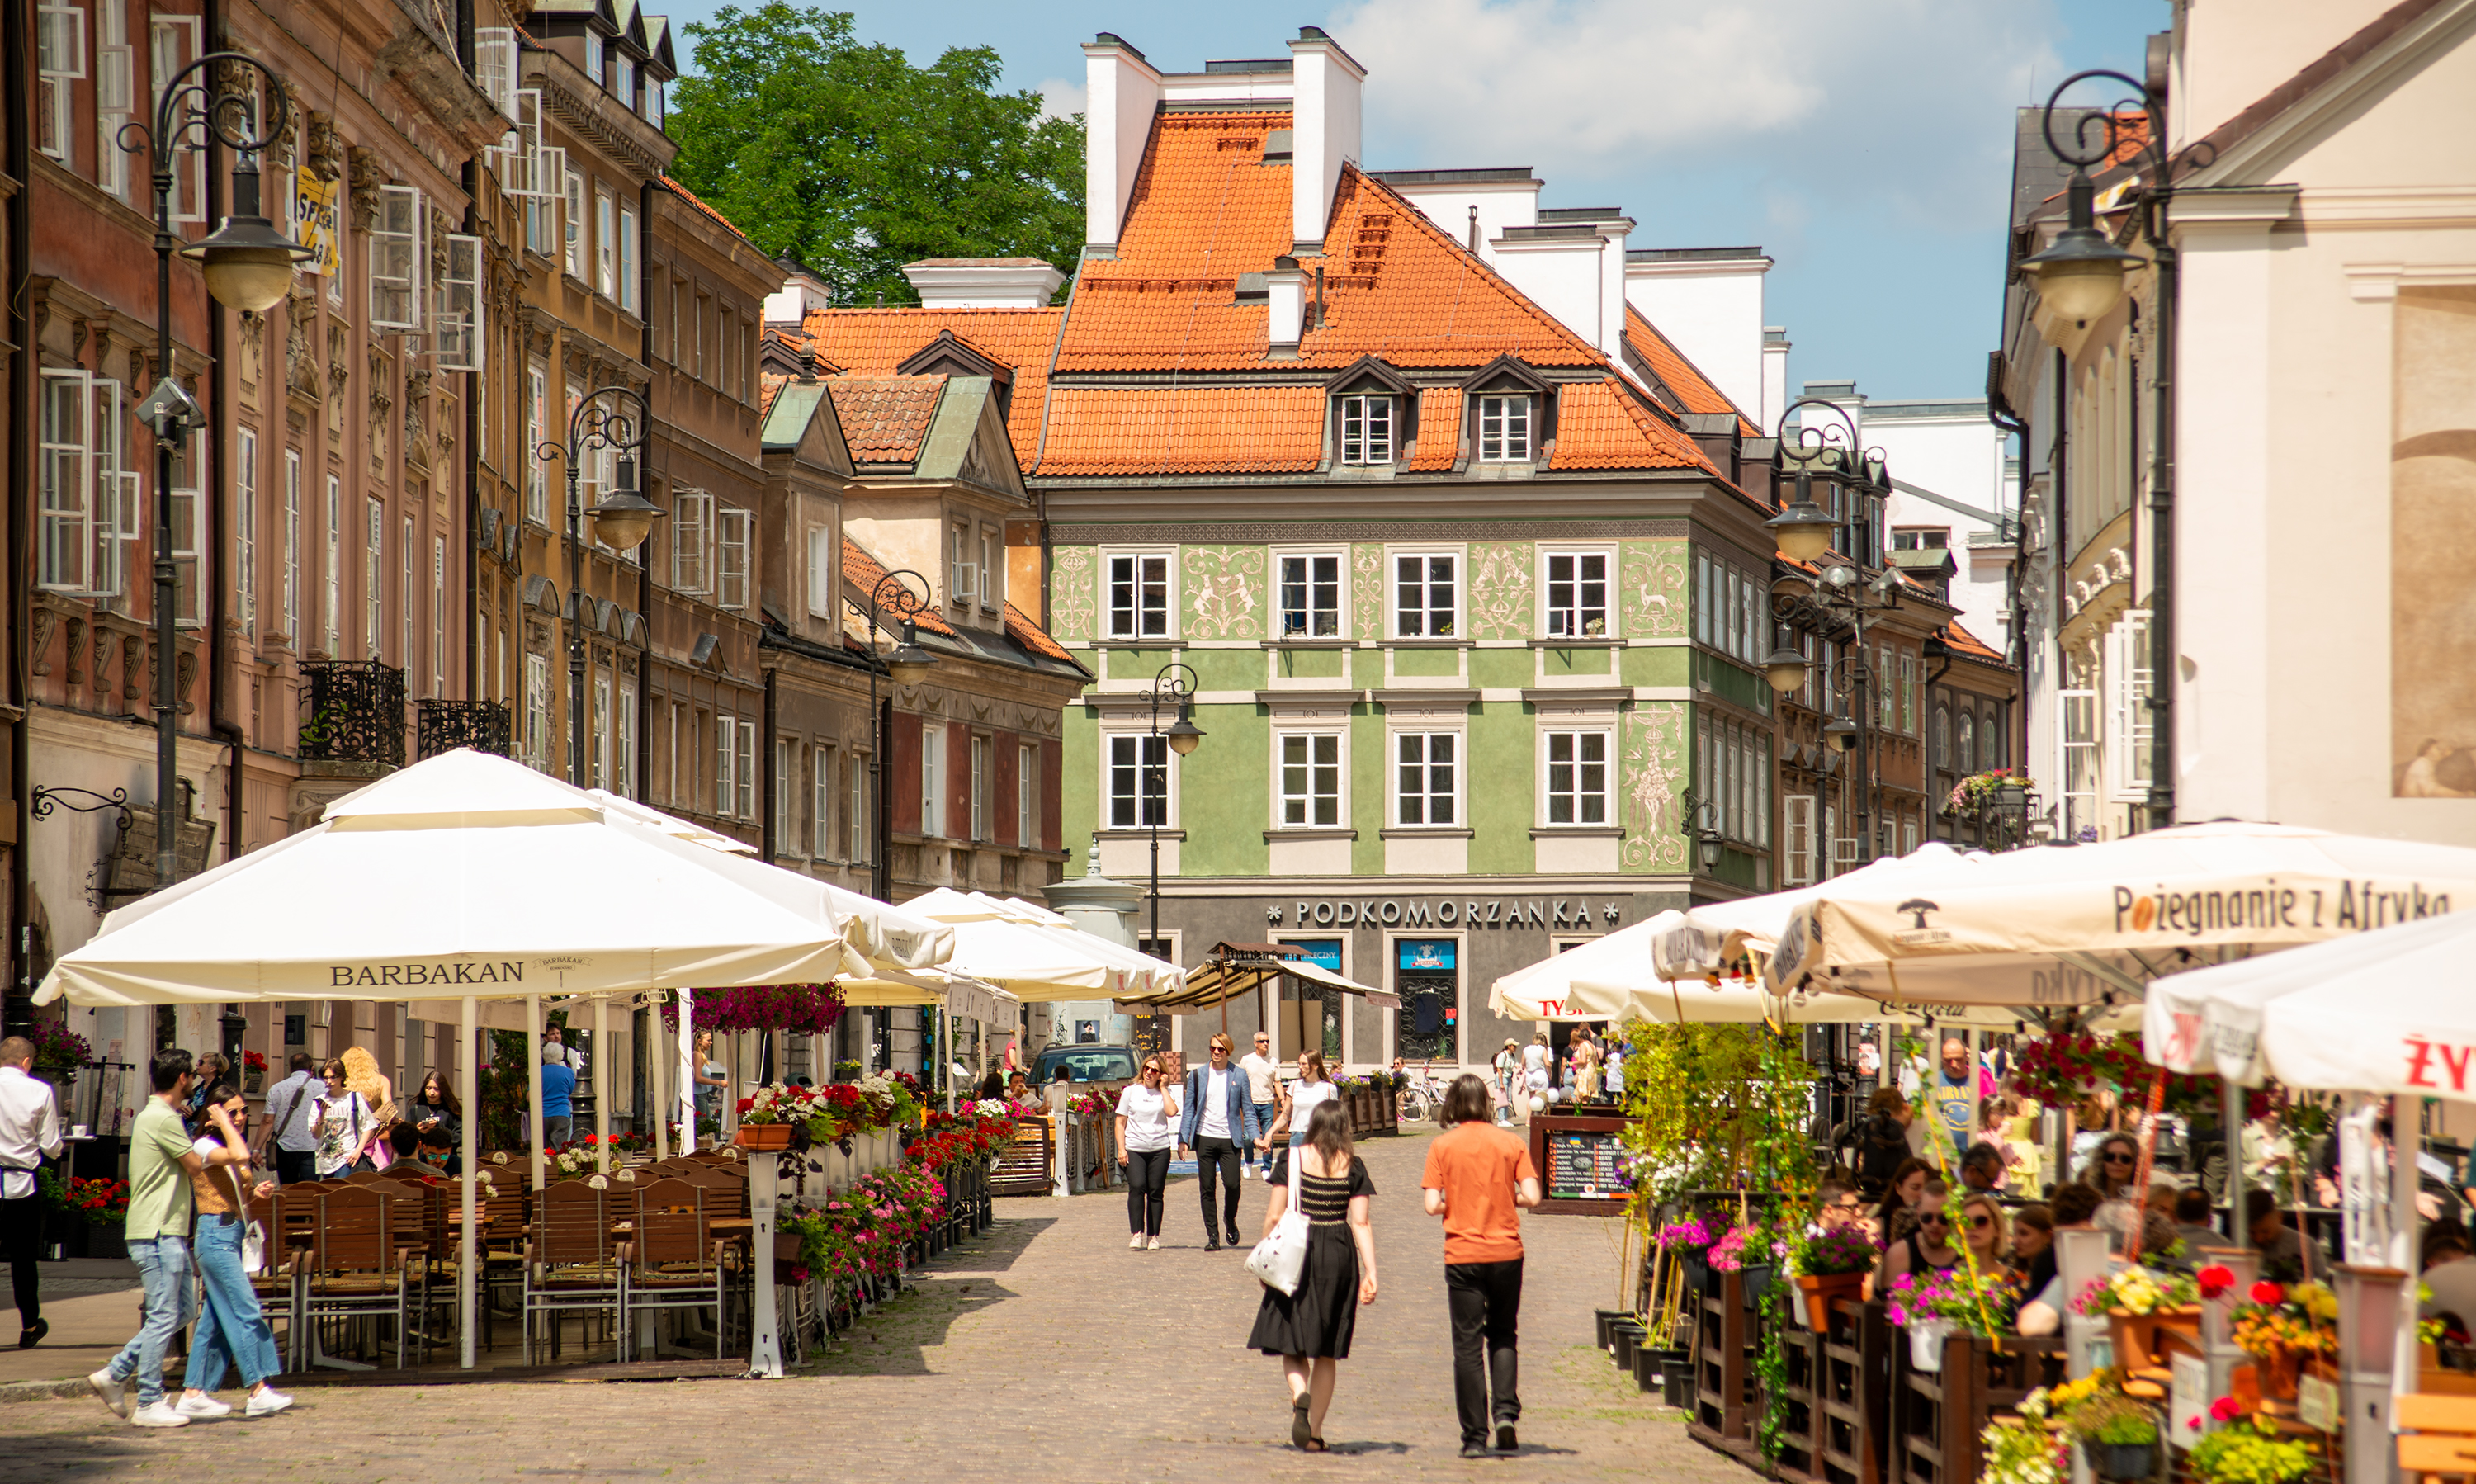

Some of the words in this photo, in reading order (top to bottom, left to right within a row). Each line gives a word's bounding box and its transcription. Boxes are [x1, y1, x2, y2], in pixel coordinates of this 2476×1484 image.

[1297, 900, 1591, 924] PODKOMORZANKA
[2309, 889, 2322, 927] z
[541, 957, 583, 966] BARBAKAN
[330, 962, 523, 987] BARBAKAN
[2403, 1033, 2476, 1091] ŻY
